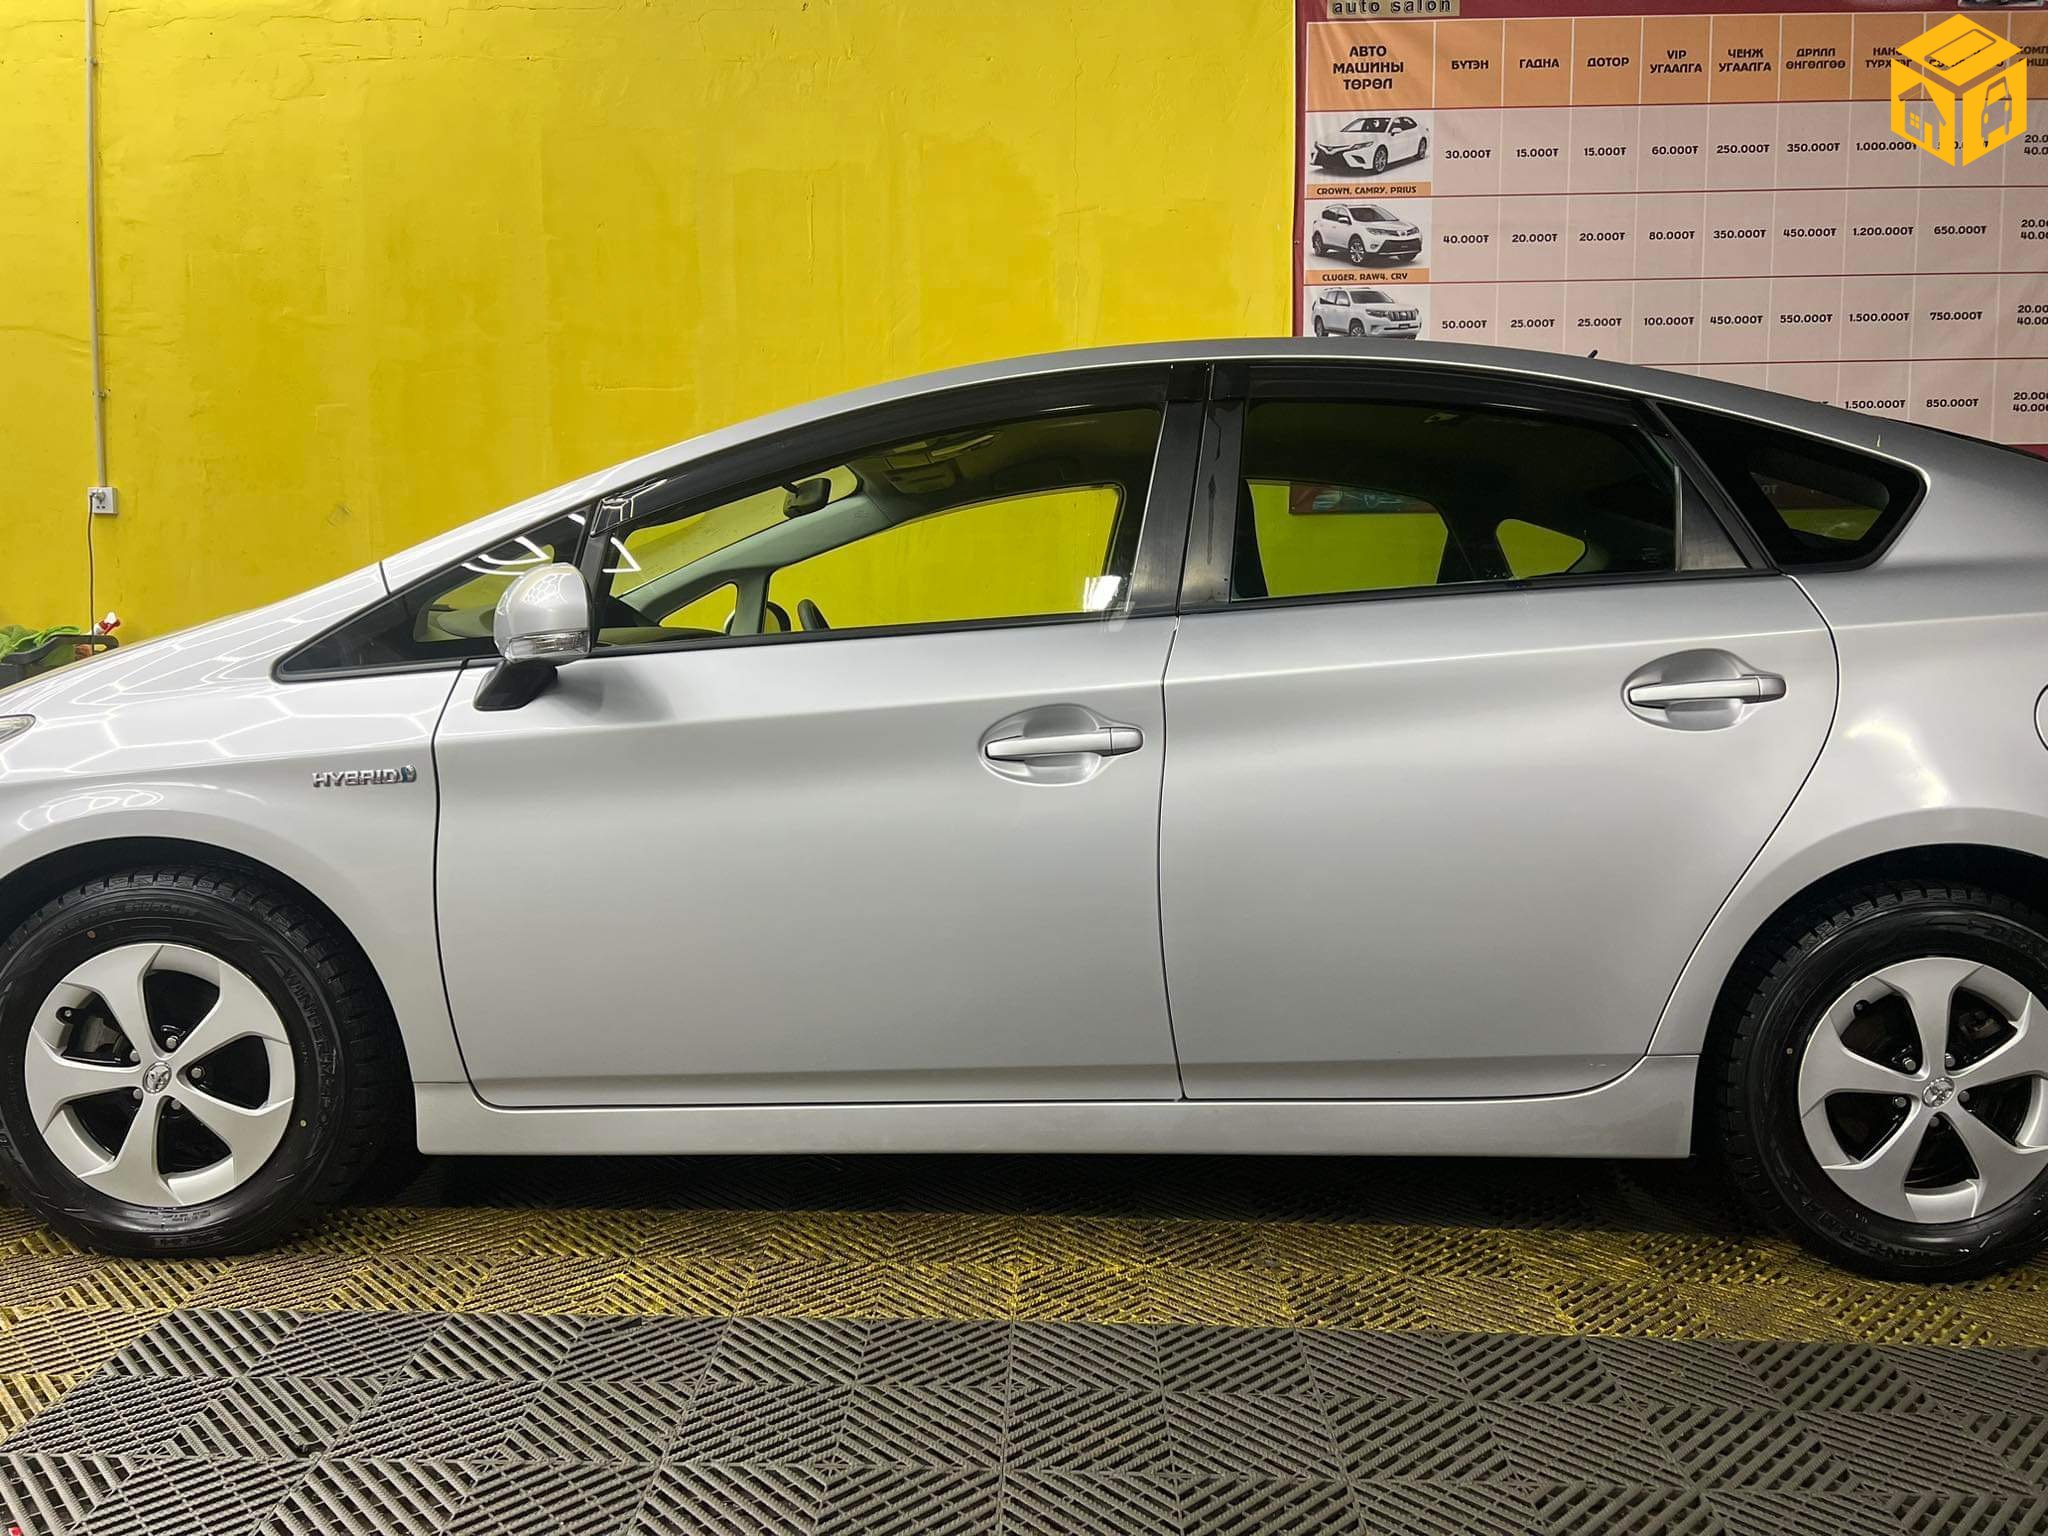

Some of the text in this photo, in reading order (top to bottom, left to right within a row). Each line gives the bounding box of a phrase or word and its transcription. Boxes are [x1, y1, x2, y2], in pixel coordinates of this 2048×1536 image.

[1332, 0, 1451, 13] auto salon
[1350, 46, 1386, 57] АВТО
[1667, 50, 1686, 59] VIP
[1728, 49, 1763, 58] ЧЕНЖ
[1796, 48, 1835, 57] ДРИЛЛ
[1452, 60, 1488, 69] БҮТЭН
[1520, 59, 1559, 68] ГАДНА
[1587, 57, 1629, 67] ДОТОР
[1786, 60, 1845, 69] ӨНГӨЛГӨӨ
[1333, 62, 1403, 73] МАШИНЫ
[1650, 64, 1702, 73] УГААЛГА
[1719, 62, 1771, 72] УГААЛГА
[1343, 78, 1392, 90] ТӨРӨЛ
[2014, 392, 2048, 400] 20.00
[2013, 404, 2048, 412] 40.00
[312, 768, 401, 787] HYBRID
